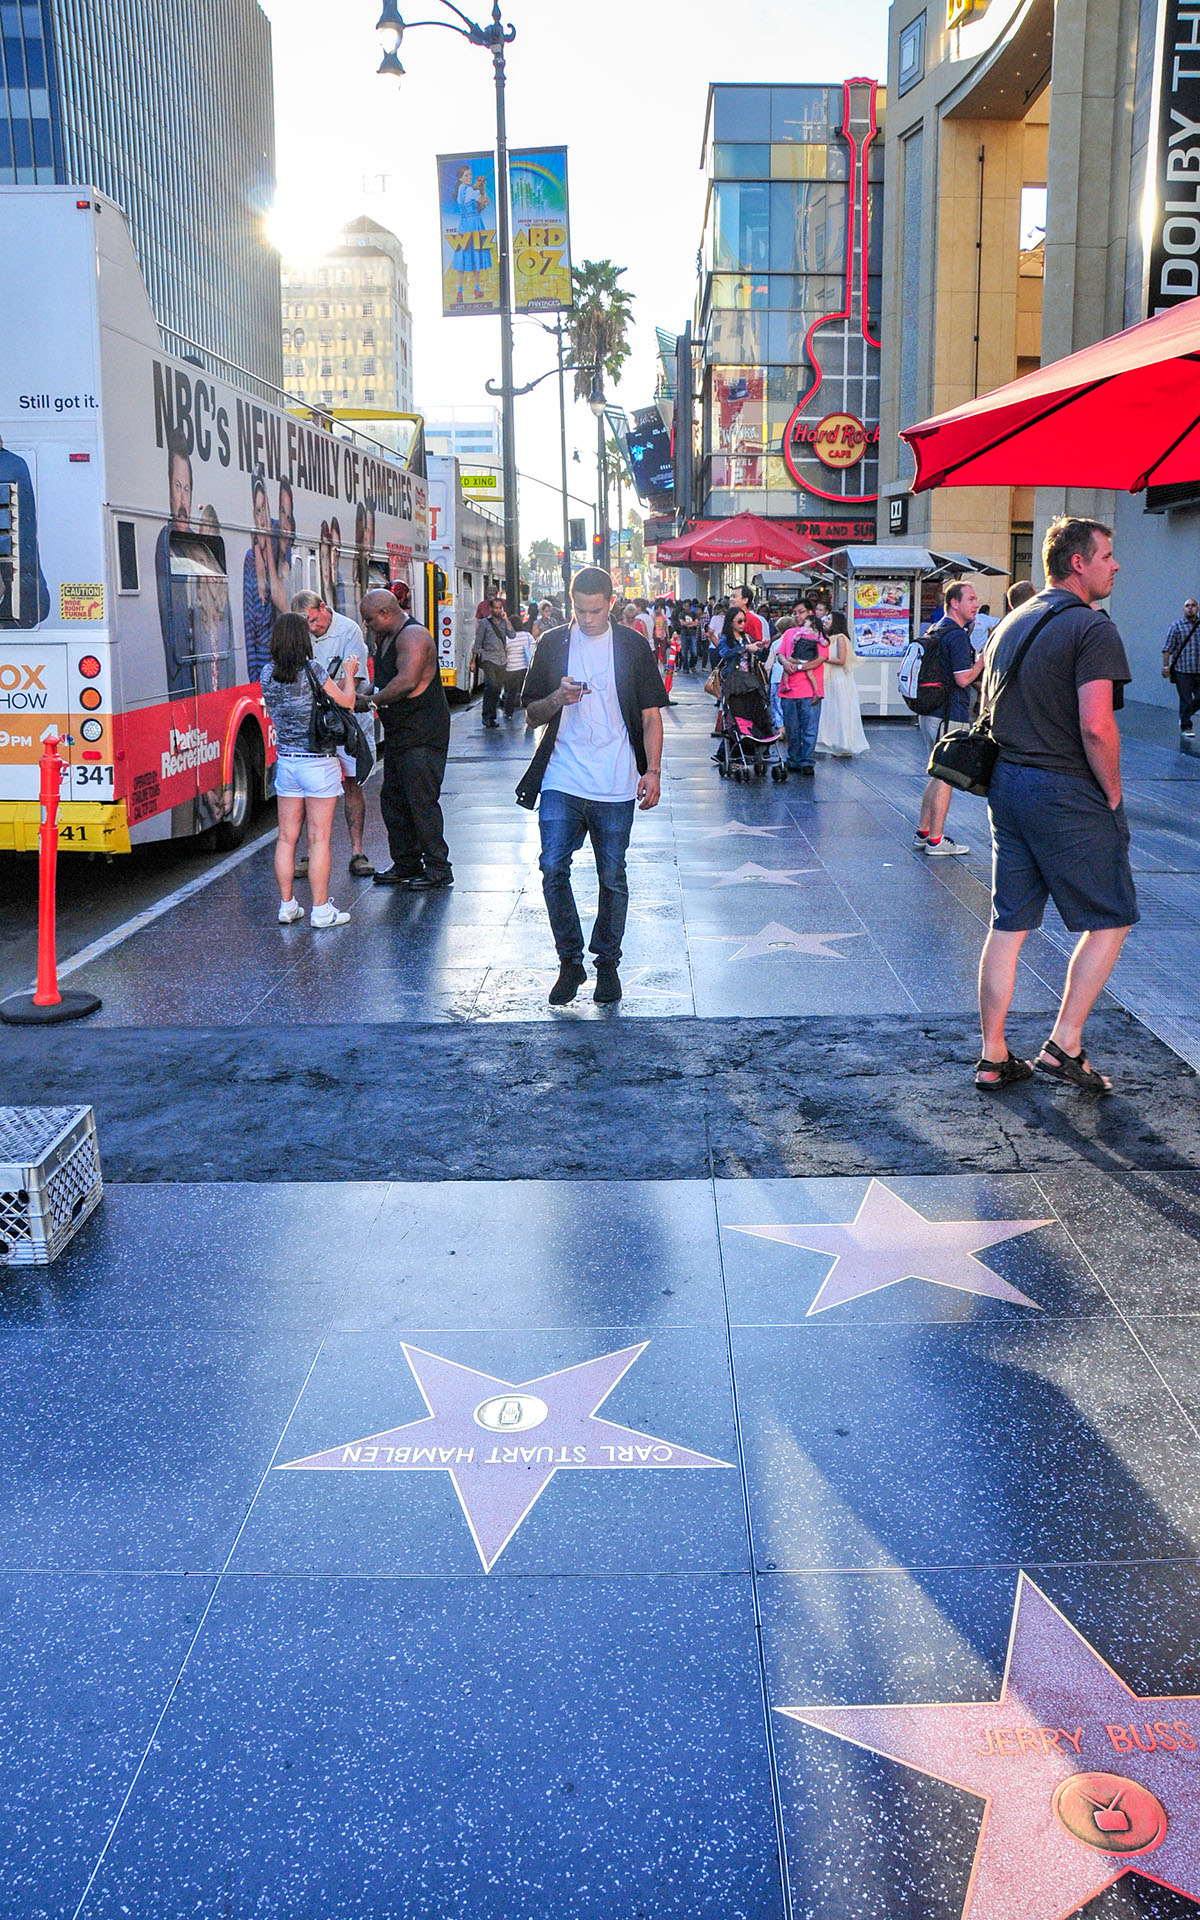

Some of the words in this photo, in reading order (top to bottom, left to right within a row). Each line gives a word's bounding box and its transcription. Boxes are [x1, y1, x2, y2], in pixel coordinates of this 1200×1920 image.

[1171, 0, 1200, 93] TH
[1160, 108, 1200, 296] DOLBY
[517, 250, 565, 276] OZ
[19, 394, 50, 409] Still
[54, 395, 80, 412] got
[84, 394, 99, 408] it.
[153, 360, 231, 467] NBC's
[236, 398, 281, 481] NEW
[287, 421, 340, 499] FAMILY
[343, 447, 360, 504] OF
[362, 456, 413, 521] COMEDIES
[793, 424, 840, 444] Hard
[828, 449, 852, 458] CAFE
[826, 526, 848, 536] AND
[65, 588, 99, 596] CAUTION
[169, 724, 201, 755] Parks
[161, 739, 220, 779] Recreation
[76, 765, 114, 785] 341
[341, 1446, 475, 1464] HAMBLEN
[485, 1445, 586, 1464] STUART
[600, 1445, 673, 1462] CARL
[977, 1726, 1083, 1757] JERRY
[1106, 1720, 1198, 1752] BUSS
